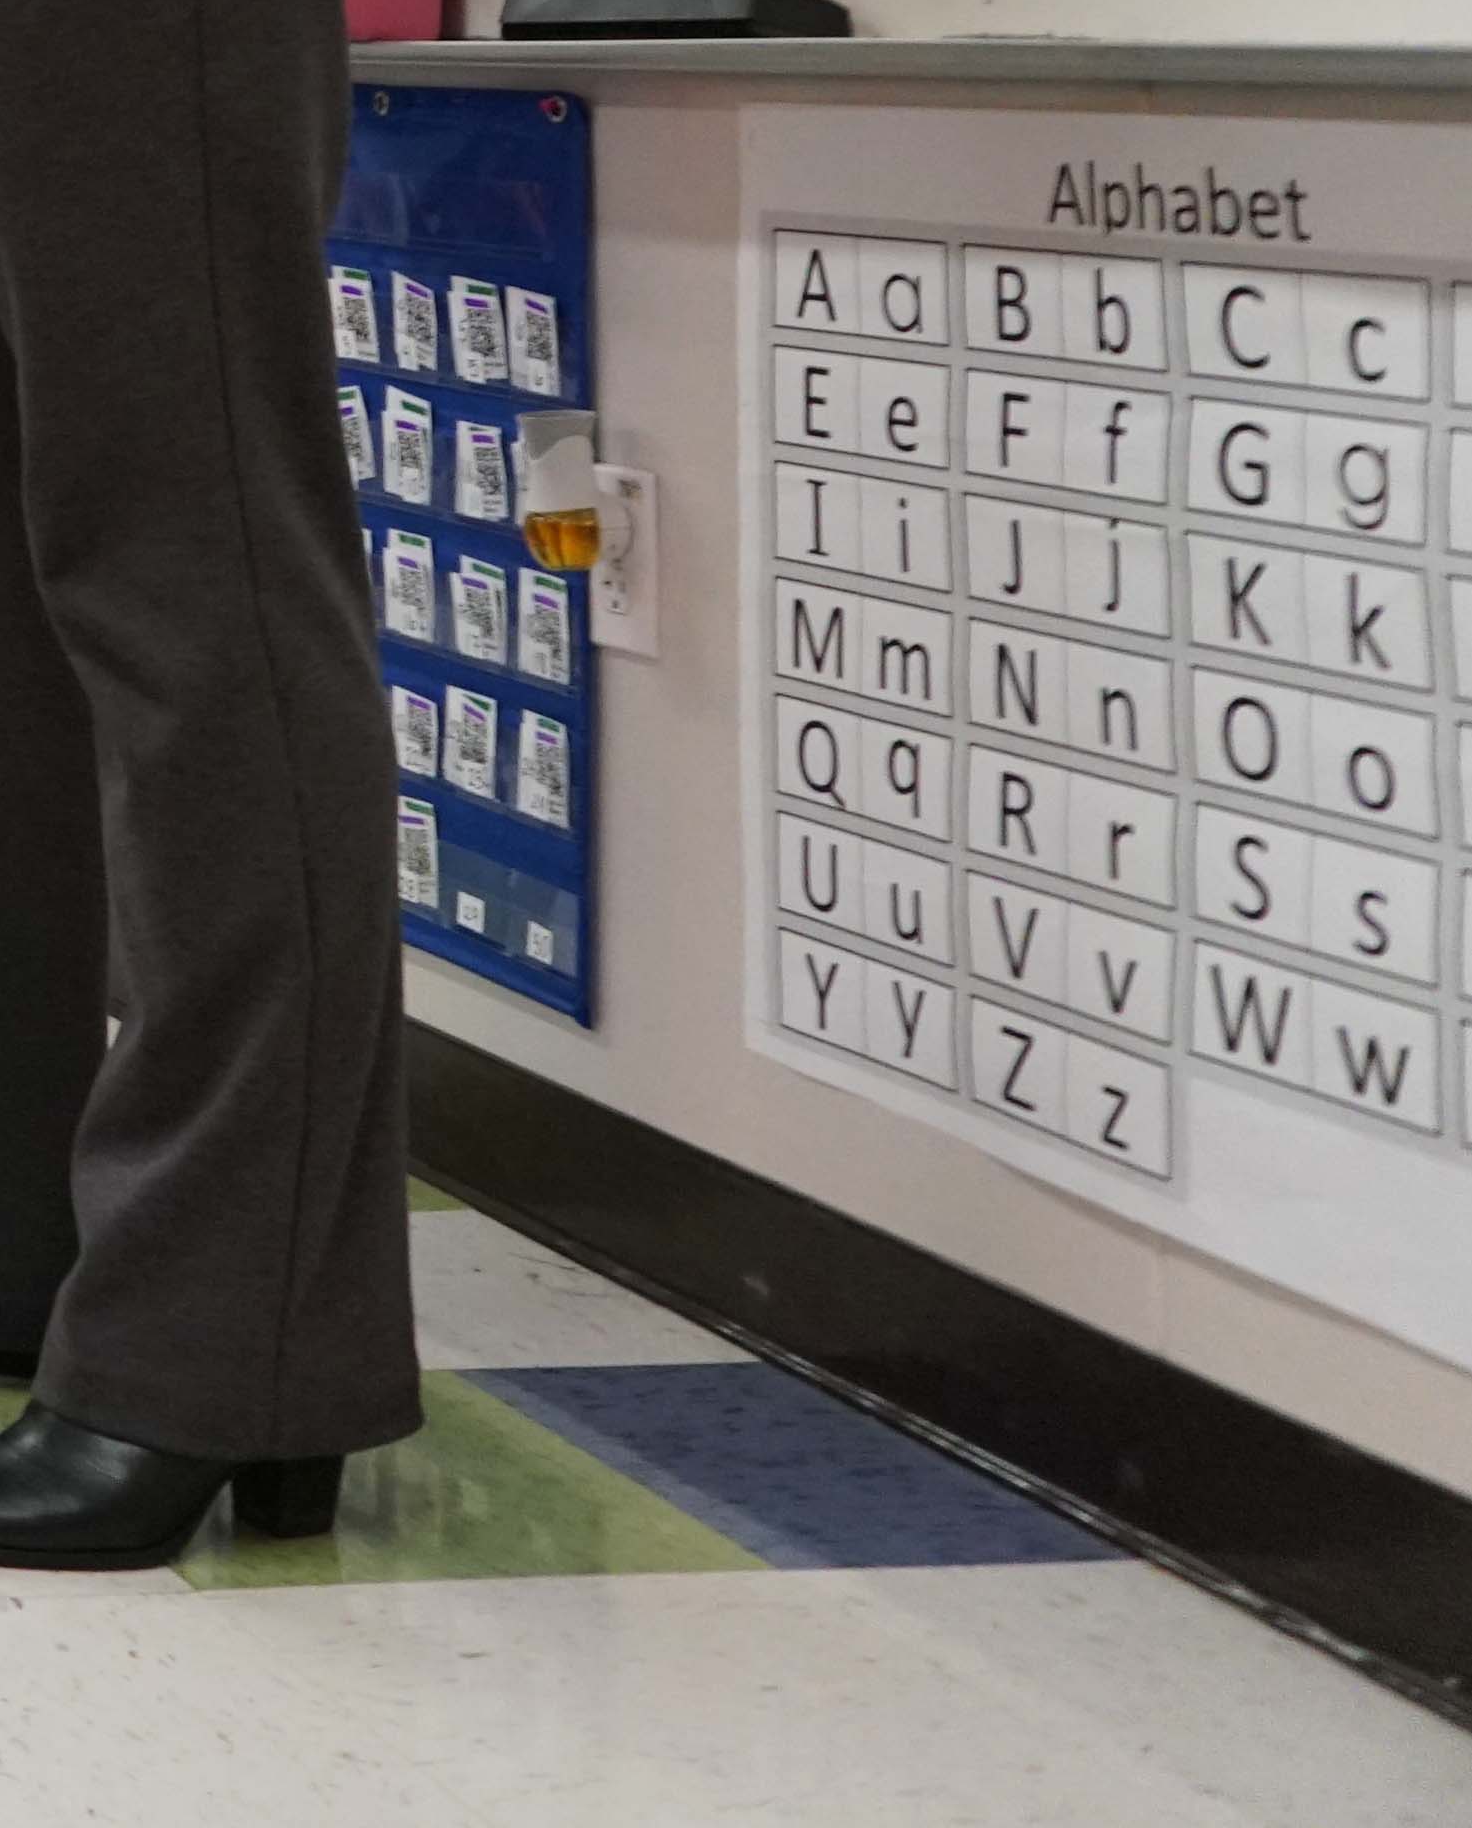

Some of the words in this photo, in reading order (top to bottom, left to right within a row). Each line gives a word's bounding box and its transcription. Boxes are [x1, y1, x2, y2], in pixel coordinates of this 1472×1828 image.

[1044, 160, 1311, 247] Alphabet
[796, 243, 839, 322] A
[879, 273, 923, 339] a
[994, 264, 1031, 343] B
[1093, 266, 1131, 356] b
[1218, 284, 1271, 370] C
[1346, 317, 1386, 384] c
[803, 365, 832, 439] E
[885, 396, 919, 452] e
[999, 391, 1030, 468] F
[1103, 400, 1132, 485] f
[1214, 422, 1270, 514] G
[1334, 443, 1390, 534] g
[1000, 520, 1022, 596] J
[1222, 557, 1272, 650] K
[1346, 572, 1391, 671] k
[789, 598, 844, 682] M
[873, 636, 932, 703] m
[991, 643, 1039, 729] N
[1099, 687, 1138, 751] n
[1218, 695, 1279, 787] O
[792, 720, 851, 812] Q
[887, 739, 920, 818] q
[993, 771, 1037, 859] R
[1108, 821, 1135, 880] r
[1225, 835, 1271, 924] S
[796, 835, 839, 917] U
[884, 883, 923, 947] u
[989, 892, 1044, 982] V
[1205, 959, 1297, 1070] W
[800, 948, 842, 1035] Y
[892, 976, 928, 1059] y
[993, 1021, 1042, 1113] Z
